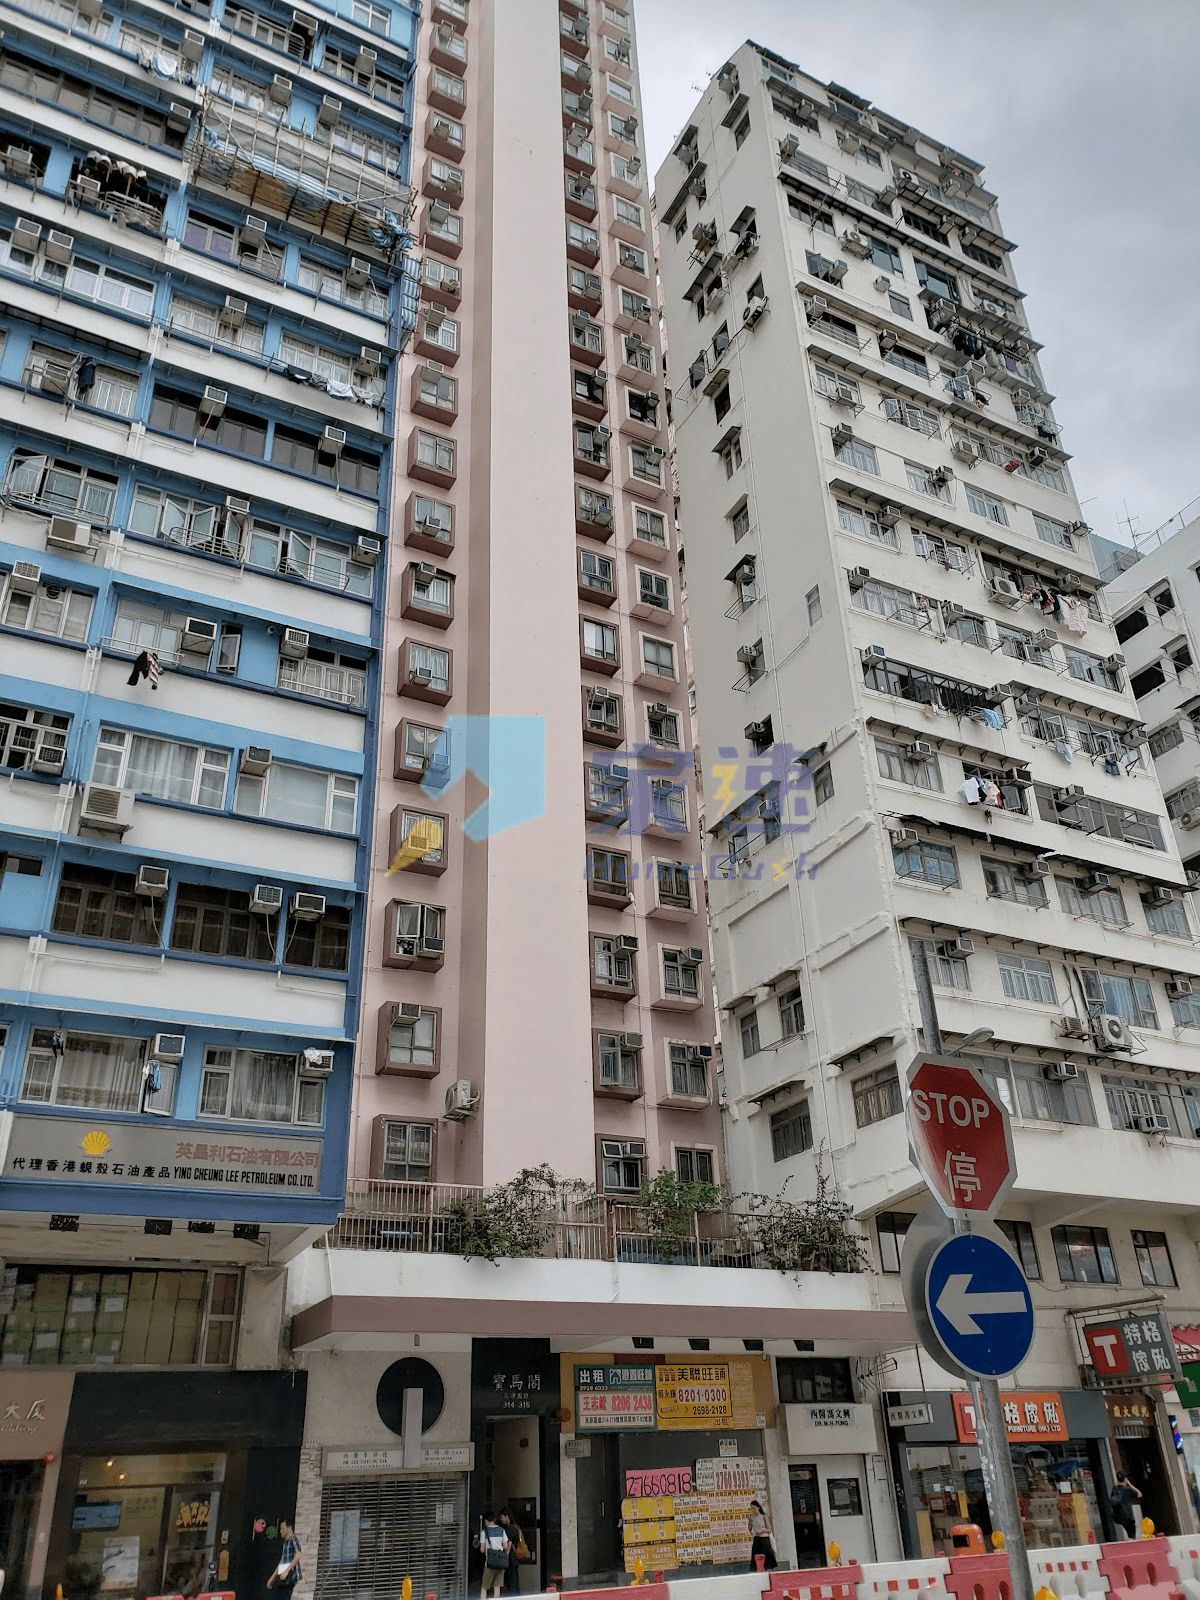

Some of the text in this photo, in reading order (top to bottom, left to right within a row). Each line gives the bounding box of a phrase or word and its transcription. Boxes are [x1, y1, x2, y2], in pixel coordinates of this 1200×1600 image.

[912, 1089, 990, 1129] STOP
[174, 1166, 192, 1180] YING
[194, 1167, 224, 1182] CHEUNG
[225, 1170, 239, 1183] LEE
[241, 1171, 285, 1186] PETROLEUM
[943, 1150, 982, 1203] 停
[1122, 1320, 1163, 1346] 特格
[1092, 1334, 1118, 1367] T
[1131, 1347, 1172, 1373] 傢俬
[493, 1373, 541, 1392] 寶馬閣
[579, 1369, 604, 1384] 出租
[1007, 1424, 1037, 1432] FURNITURE
[626, 1472, 692, 1497] 27660818
